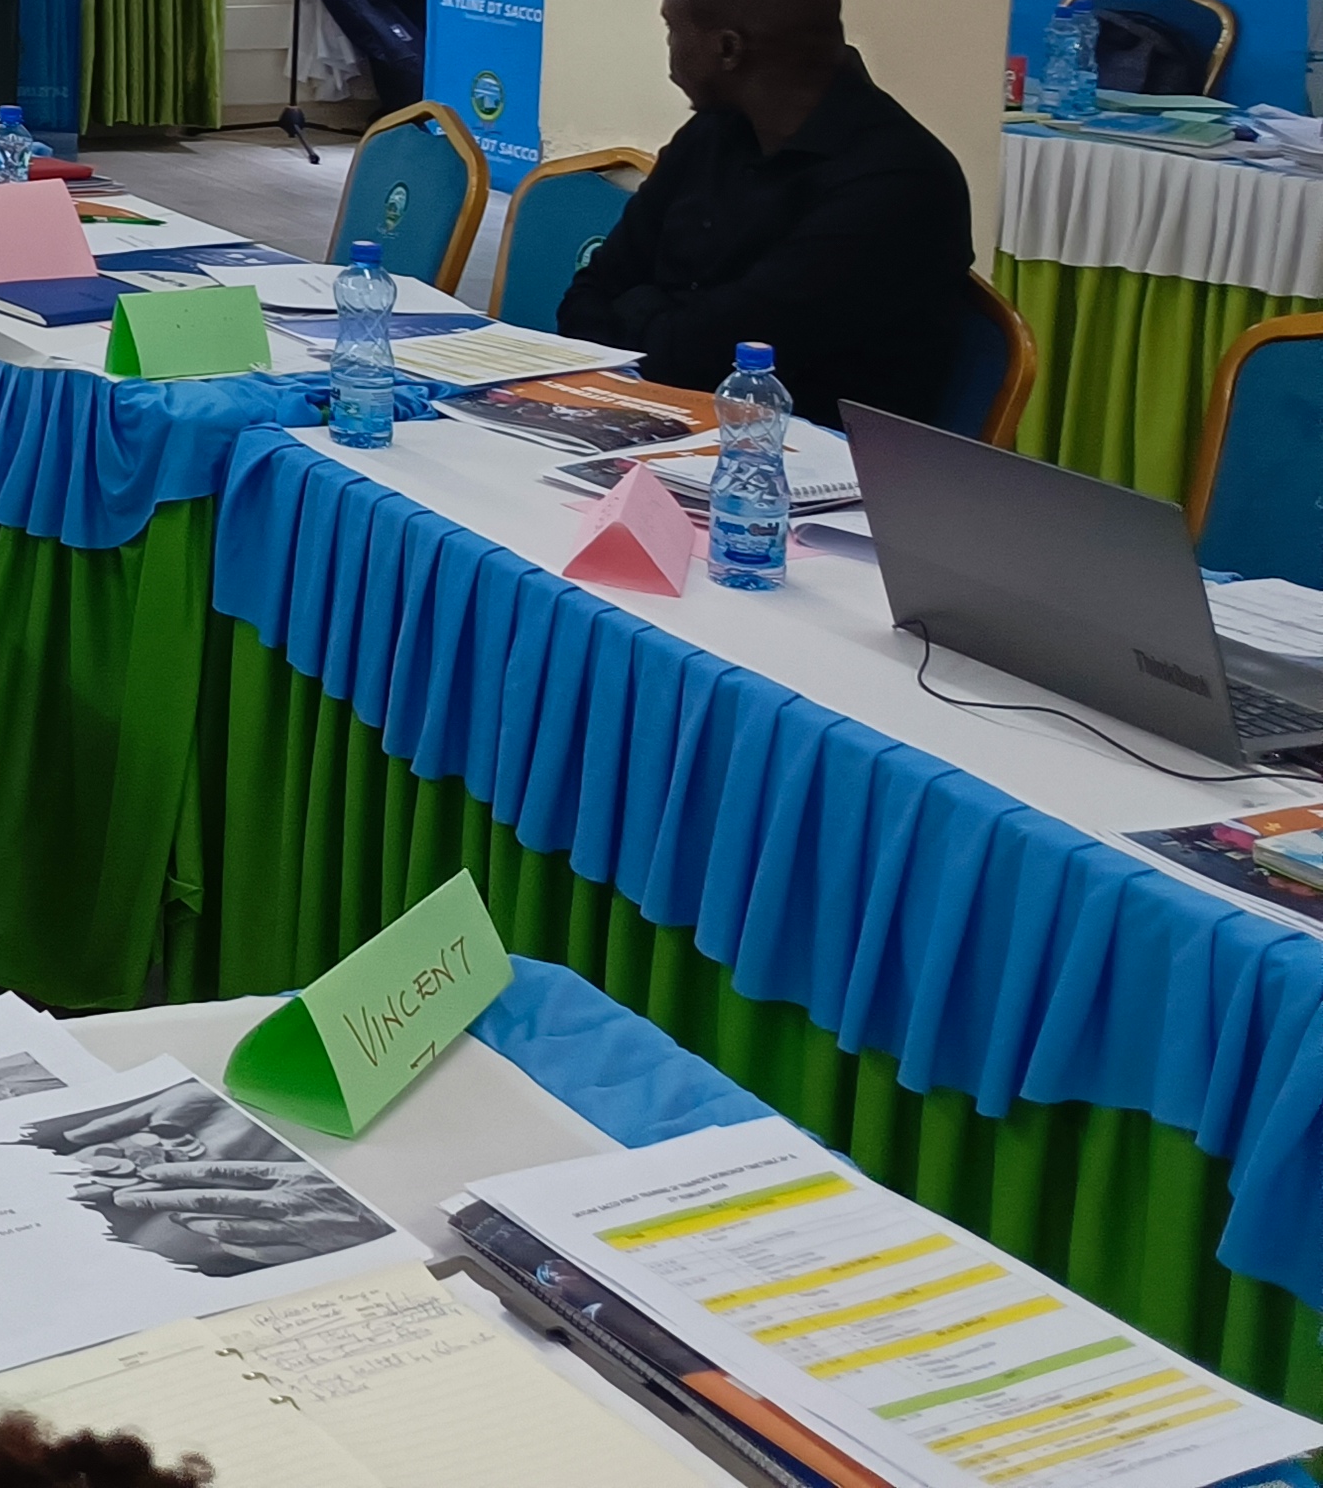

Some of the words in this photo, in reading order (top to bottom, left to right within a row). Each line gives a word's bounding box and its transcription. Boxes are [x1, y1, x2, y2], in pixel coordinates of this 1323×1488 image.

[487, 0, 503, 15] DT
[504, 4, 542, 22] SACCO
[481, 137, 497, 152] DT
[498, 142, 539, 162] SACCO
[342, 936, 473, 1069] VINCENT
